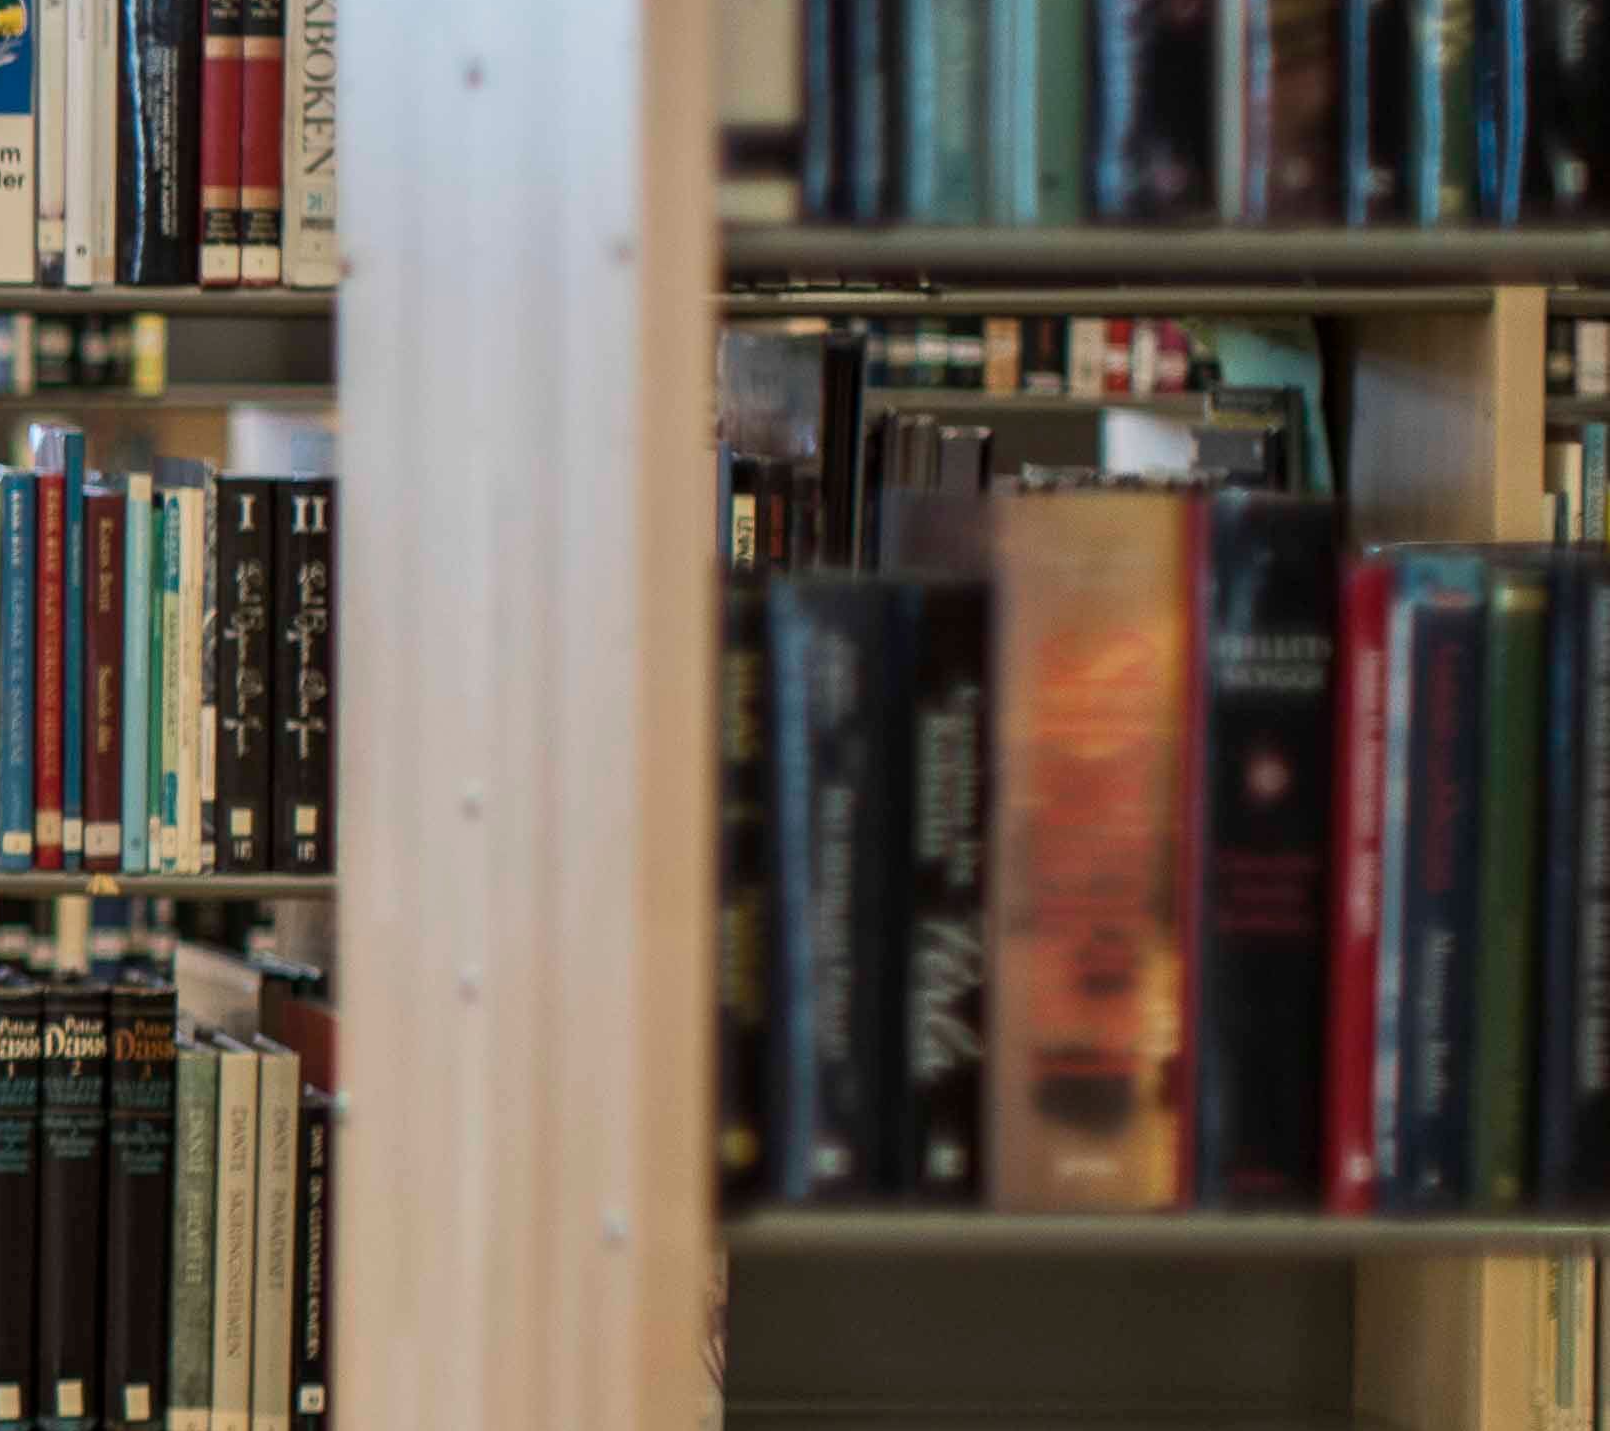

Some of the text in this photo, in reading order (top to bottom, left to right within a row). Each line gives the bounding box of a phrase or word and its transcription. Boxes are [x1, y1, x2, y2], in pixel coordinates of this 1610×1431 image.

[239, 496, 254, 532] I
[292, 496, 328, 533] II
[231, 1105, 249, 1173] DANTE
